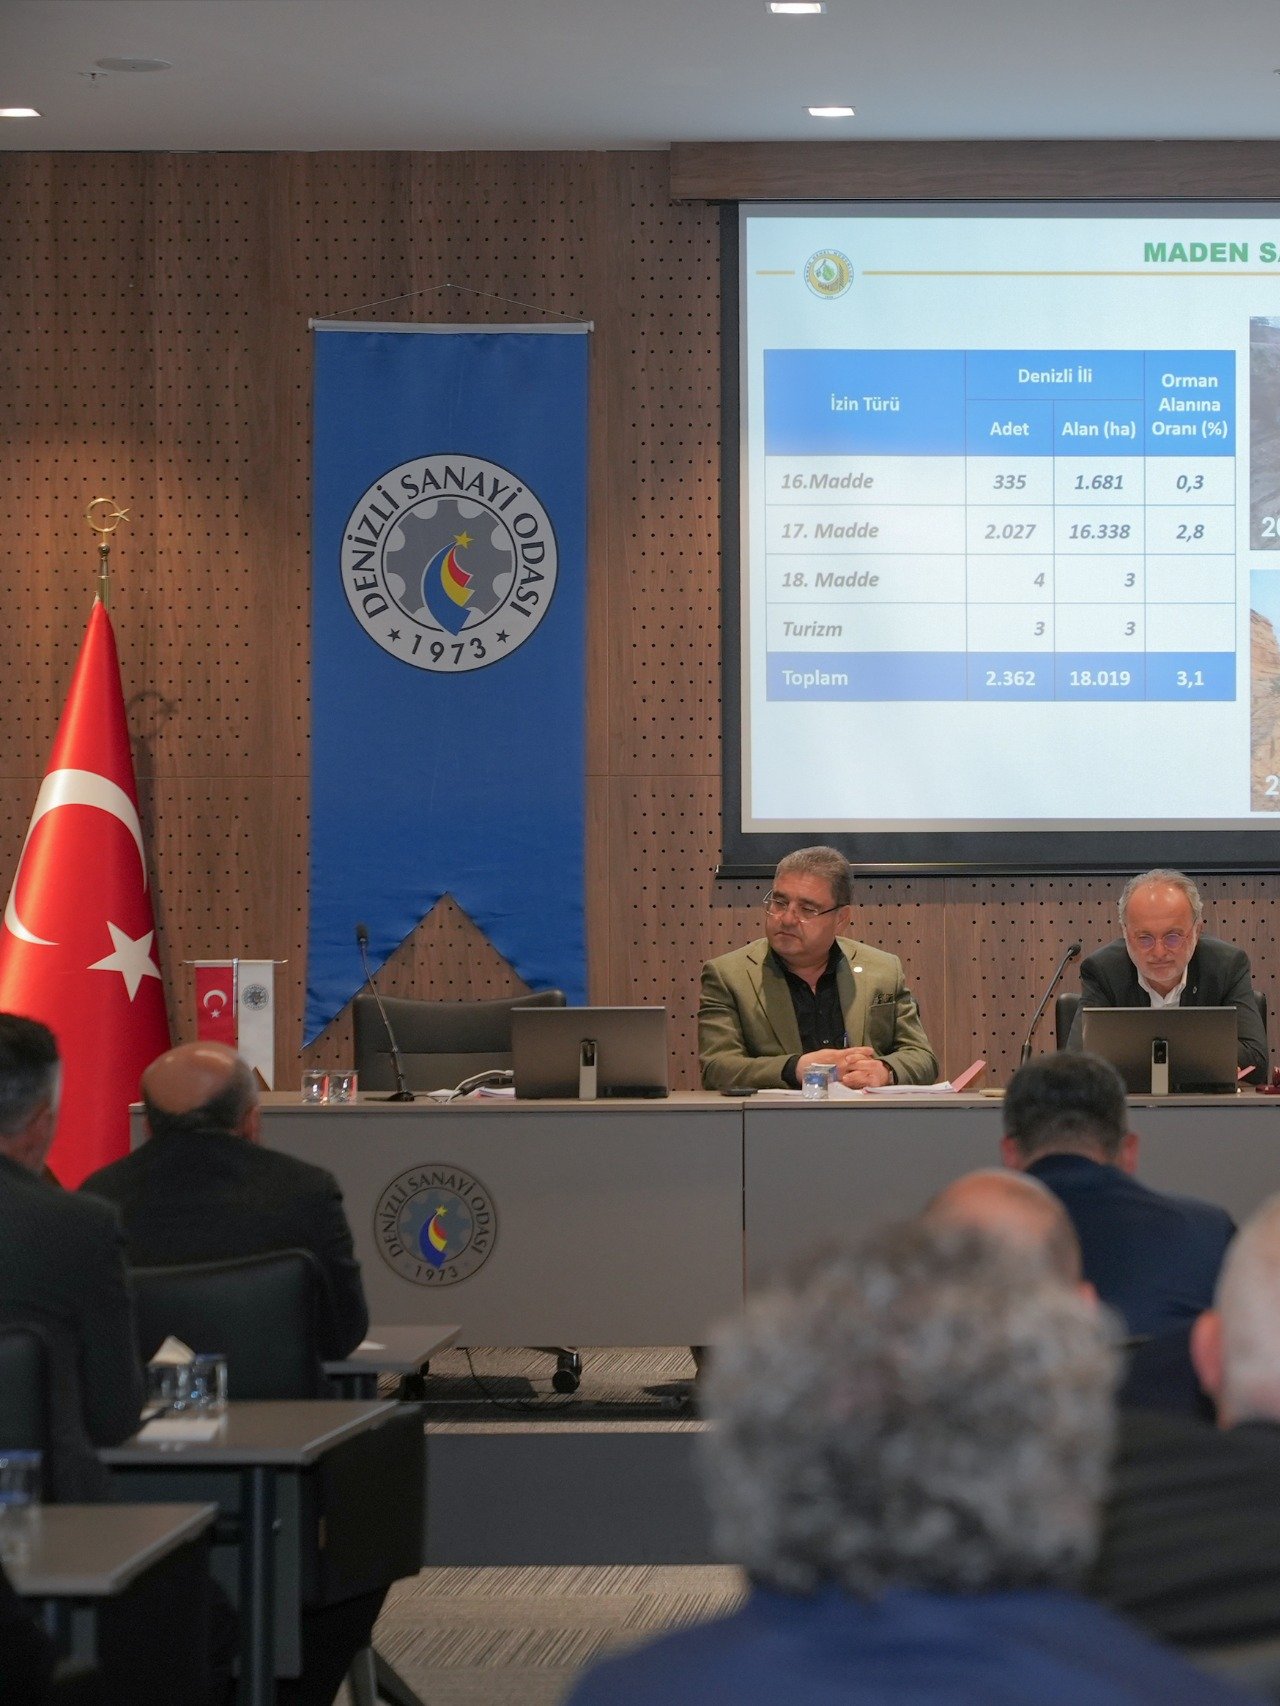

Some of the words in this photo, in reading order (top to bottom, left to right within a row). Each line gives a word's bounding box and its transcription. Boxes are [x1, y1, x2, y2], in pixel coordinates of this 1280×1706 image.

[1144, 242, 1249, 263] MADEN
[1017, 367, 1073, 384] Denizli
[1077, 365, 1093, 384] İli
[1161, 373, 1219, 388] Orman
[830, 393, 859, 411] İzin
[863, 396, 900, 412] Türü
[1158, 397, 1221, 412] Alanına
[989, 421, 1030, 436] Adet
[1061, 421, 1100, 436] Alan
[1103, 420, 1137, 439] (ha)
[1151, 421, 1197, 436] Oranı
[1201, 420, 1229, 439] (%)
[781, 472, 874, 490] 16.Madde
[992, 474, 1027, 490] 335
[1074, 474, 1124, 490] 1.681
[1175, 474, 1205, 493] 0,3
[781, 523, 808, 539] 17.
[814, 522, 880, 539] Madde
[984, 524, 1037, 540] 2.027
[1069, 524, 1131, 540] 16.338
[1175, 524, 1205, 542] 2,8
[347, 484, 400, 619] DENİZLİ
[400, 465, 523, 512] SANAYİ
[512, 512, 546, 618] ODASI
[782, 572, 809, 588] 18.
[814, 571, 880, 588] Madde
[1033, 572, 1046, 588] 4
[1124, 572, 1136, 588] 3
[782, 620, 843, 637] Turizm
[1033, 621, 1046, 636] 3
[1124, 621, 1136, 636] 3
[410, 633, 487, 665] 1973
[782, 669, 849, 689] Toplam
[985, 670, 1036, 687] 2.362
[1069, 670, 1131, 687] 18.019
[1176, 670, 1205, 688] 3,1
